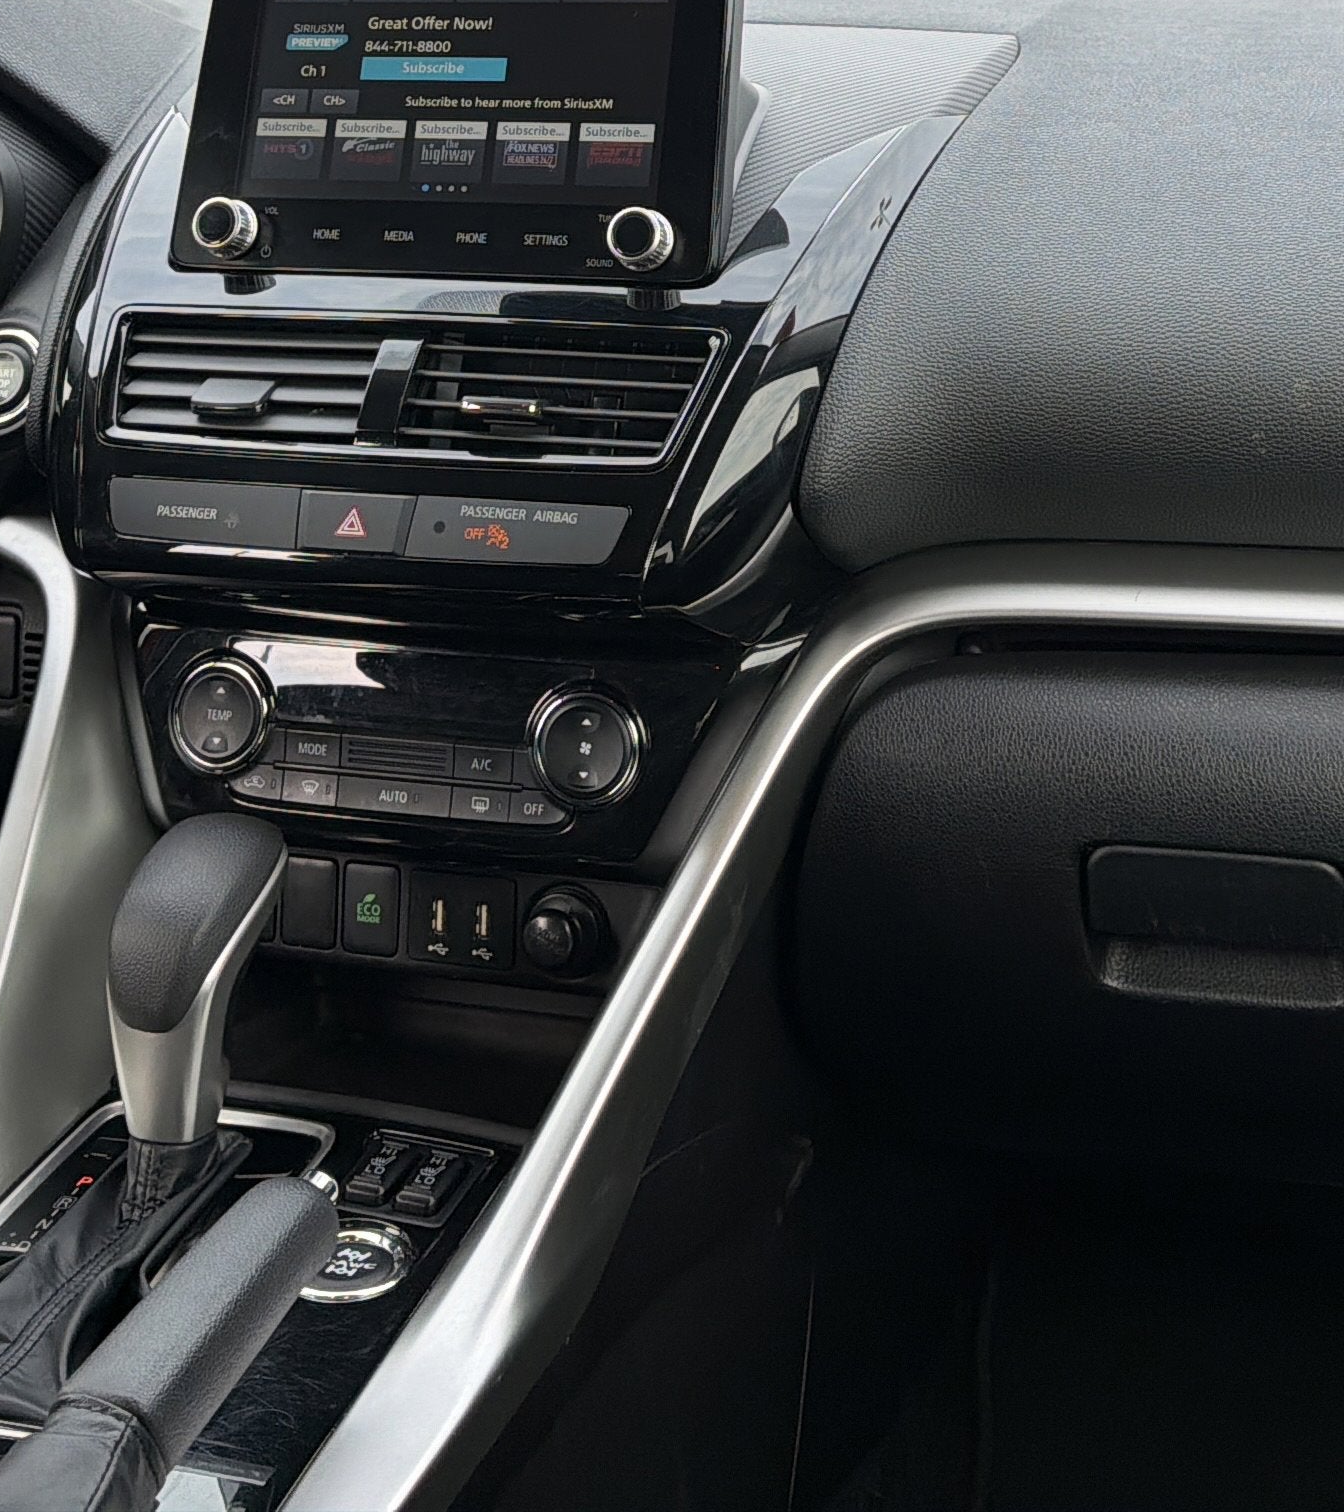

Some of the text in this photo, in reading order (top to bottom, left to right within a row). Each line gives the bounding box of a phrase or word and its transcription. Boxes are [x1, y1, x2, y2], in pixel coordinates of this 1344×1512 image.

[293, 23, 345, 34] SIRIUSXM
[367, 16, 494, 31] Great Offer Now!
[364, 40, 452, 54] 844-711-8800
[300, 64, 327, 78] Ch 1
[402, 61, 465, 75] Subscribe
[405, 96, 614, 110] Subscribe to hear more from SiriusXM
[420, 144, 476, 165] highway
[507, 143, 555, 154] FOX NEWS
[264, 206, 280, 216] VOL
[312, 228, 341, 241] HOME
[383, 229, 415, 242] MEDIA
[455, 232, 489, 245] PHONE
[522, 233, 569, 247] SETTINGS
[585, 258, 614, 268] SOUND
[156, 504, 217, 522] PASSENGER
[459, 503, 578, 525] PASSENGER AIRBAG
[464, 526, 485, 541] OFF
[206, 707, 233, 723] TEMP
[297, 740, 328, 757] MODE
[470, 757, 492, 772] A/C
[378, 788, 408, 804] AUTO
[522, 802, 545, 818] OFF
[356, 902, 381, 916] ECO
[356, 915, 382, 925] MODE
[380, 1145, 398, 1156] HI
[430, 1155, 448, 1166] HI
[364, 1163, 386, 1175] LO
[76, 1175, 94, 1187] P
[415, 1174, 436, 1186] LO
[56, 1197, 73, 1209] R
[35, 1218, 54, 1230] N
